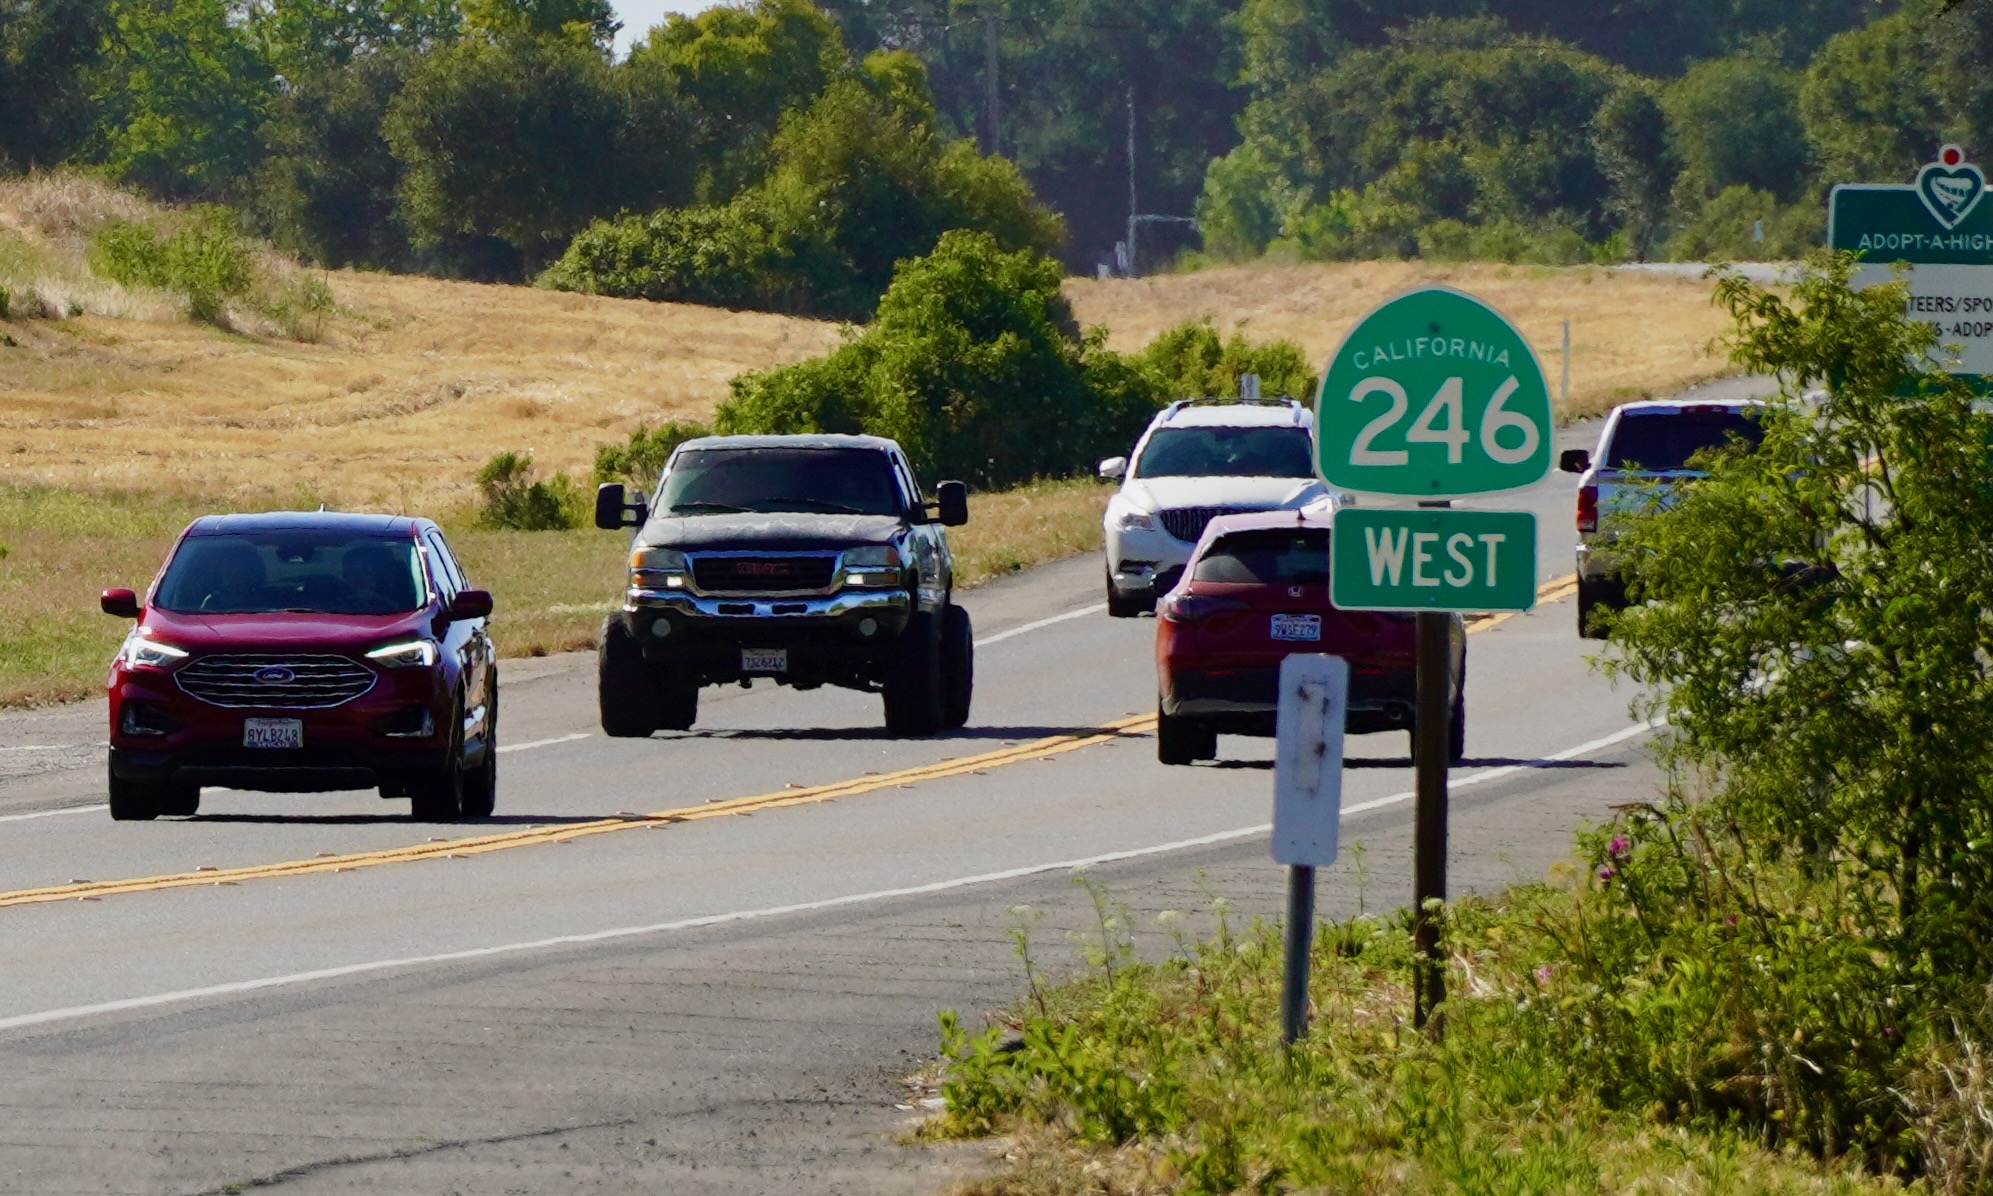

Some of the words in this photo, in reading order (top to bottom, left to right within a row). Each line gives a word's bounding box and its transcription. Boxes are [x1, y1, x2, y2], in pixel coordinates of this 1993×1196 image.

[1353, 337, 1511, 369] CALIFORNIA
[1348, 374, 1540, 466] 246
[1364, 526, 1506, 588] WEST
